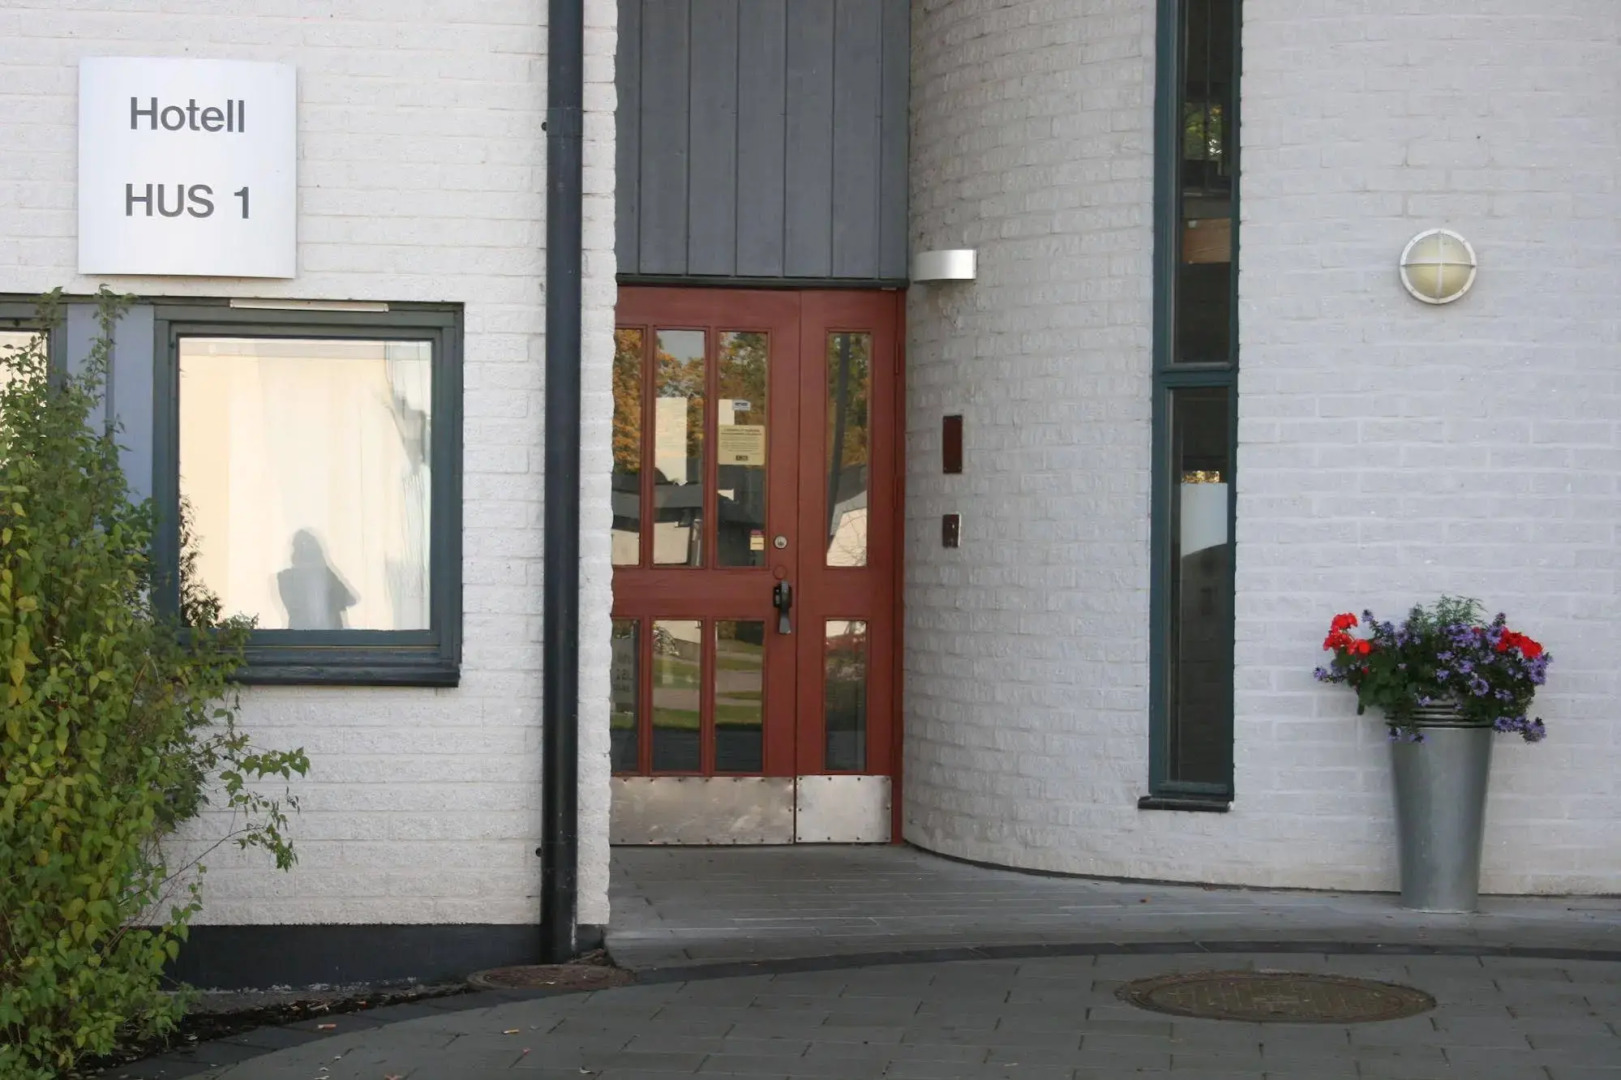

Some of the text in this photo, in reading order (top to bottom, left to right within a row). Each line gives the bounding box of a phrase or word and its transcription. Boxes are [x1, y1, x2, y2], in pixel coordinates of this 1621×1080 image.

[130, 97, 245, 133] Hotell
[125, 183, 250, 220] HUS 1
